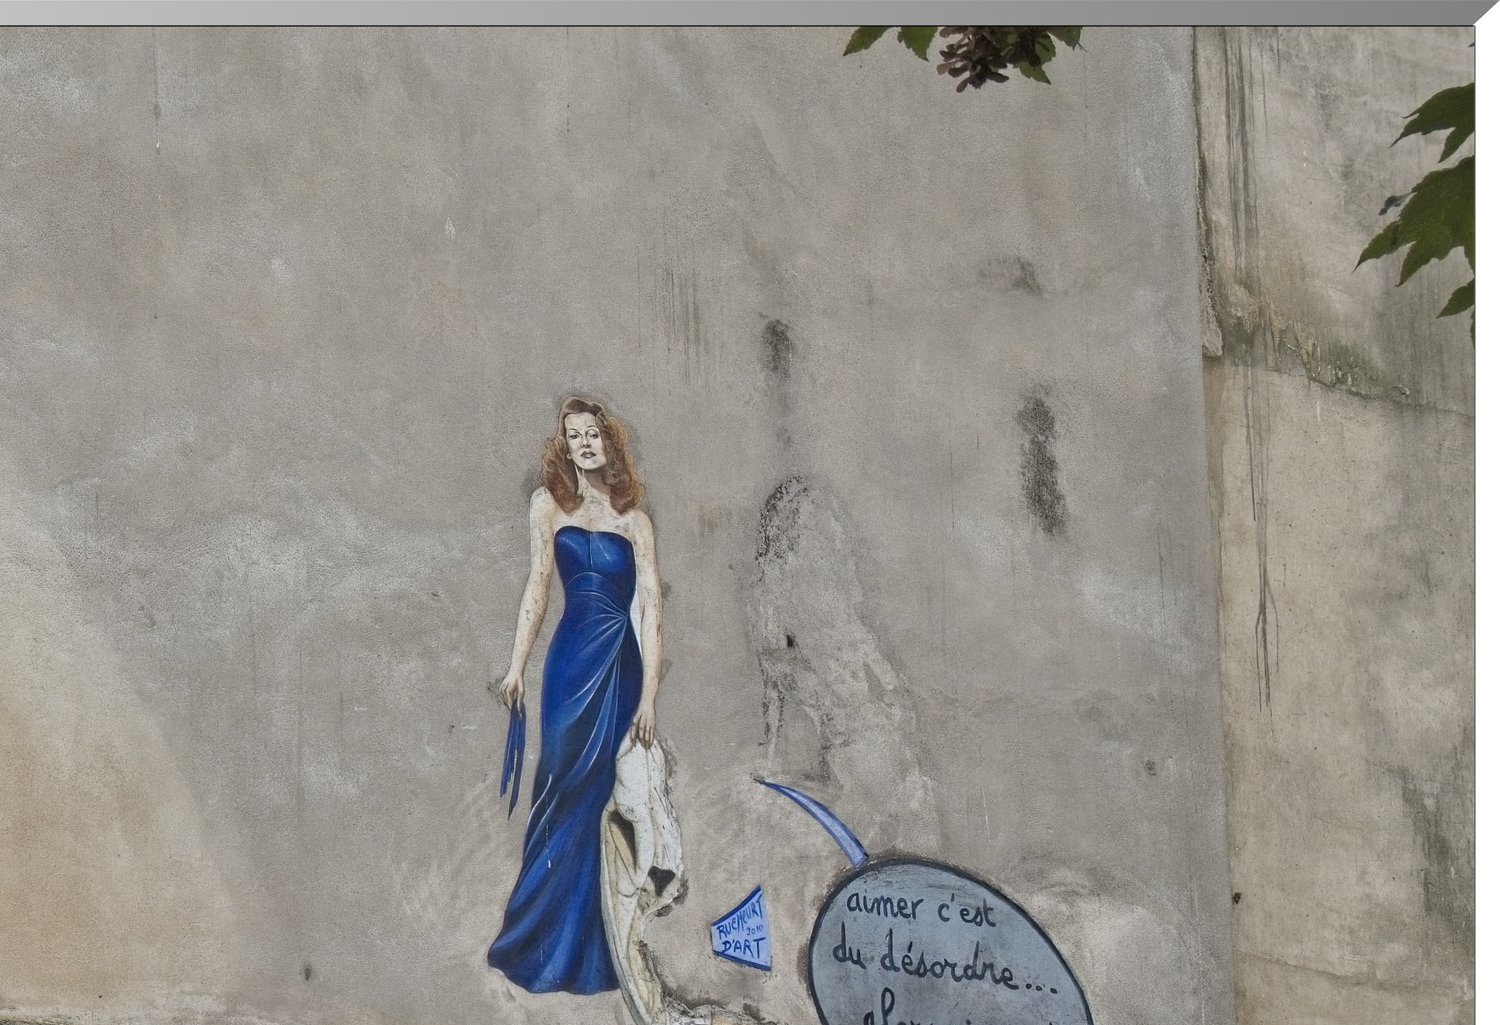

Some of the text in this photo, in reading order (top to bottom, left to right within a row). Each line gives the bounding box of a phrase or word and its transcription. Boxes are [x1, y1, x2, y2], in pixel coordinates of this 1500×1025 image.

[846, 891, 997, 928] aimer c'est
[722, 937, 766, 958] D'ART
[832, 922, 866, 969] du
